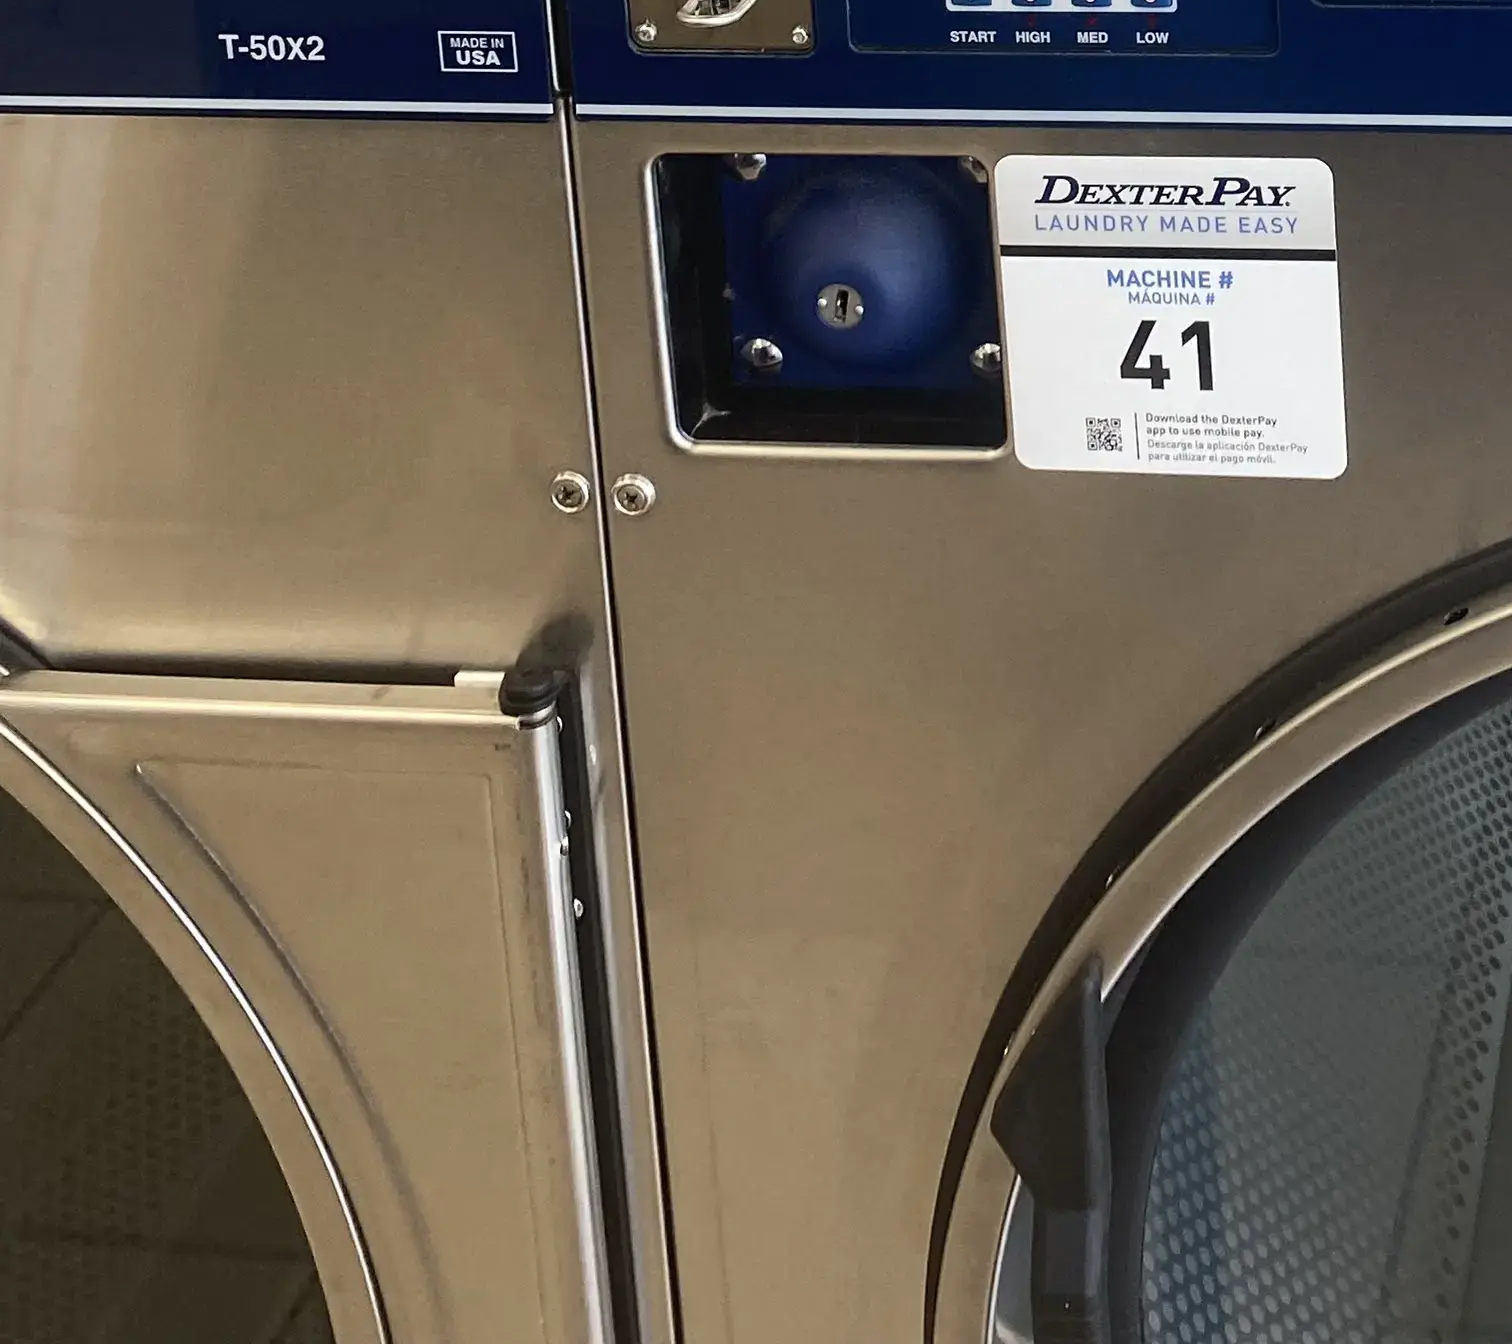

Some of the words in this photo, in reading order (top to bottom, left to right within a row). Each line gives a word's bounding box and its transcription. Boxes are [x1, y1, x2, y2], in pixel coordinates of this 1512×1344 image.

[449, 37, 487, 49] MADE
[490, 37, 505, 49] IN
[949, 30, 997, 44] START
[1015, 30, 1051, 44] HIGH
[1077, 31, 1109, 44] MED
[1136, 31, 1169, 44] LOW
[218, 33, 326, 61] T-50X2
[455, 50, 501, 67] USA
[1034, 213, 1149, 232] LAUNDRY
[1160, 215, 1227, 234] MADE
[1238, 216, 1298, 235] EASY
[1106, 269, 1212, 289] MACHINE
[1218, 270, 1234, 289] #
[1127, 286, 1201, 306] MÁQUINA
[1205, 293, 1216, 306] #
[1120, 319, 1214, 392] 41
[1145, 412, 1198, 424] Download
[1200, 414, 1219, 425] the
[1221, 414, 1277, 428] DexterPay
[1146, 426, 1166, 437] app
[1168, 426, 1179, 436] to
[1182, 427, 1201, 436] use
[1204, 426, 1241, 438] mobile
[1243, 429, 1265, 440] pay.
[1195, 439, 1204, 450] la
[1207, 440, 1256, 452] aplicación
[1258, 442, 1308, 455] DexterPay
[1148, 453, 1170, 463] para
[1172, 452, 1207, 462] utilizar
[1220, 455, 1245, 465] pago
